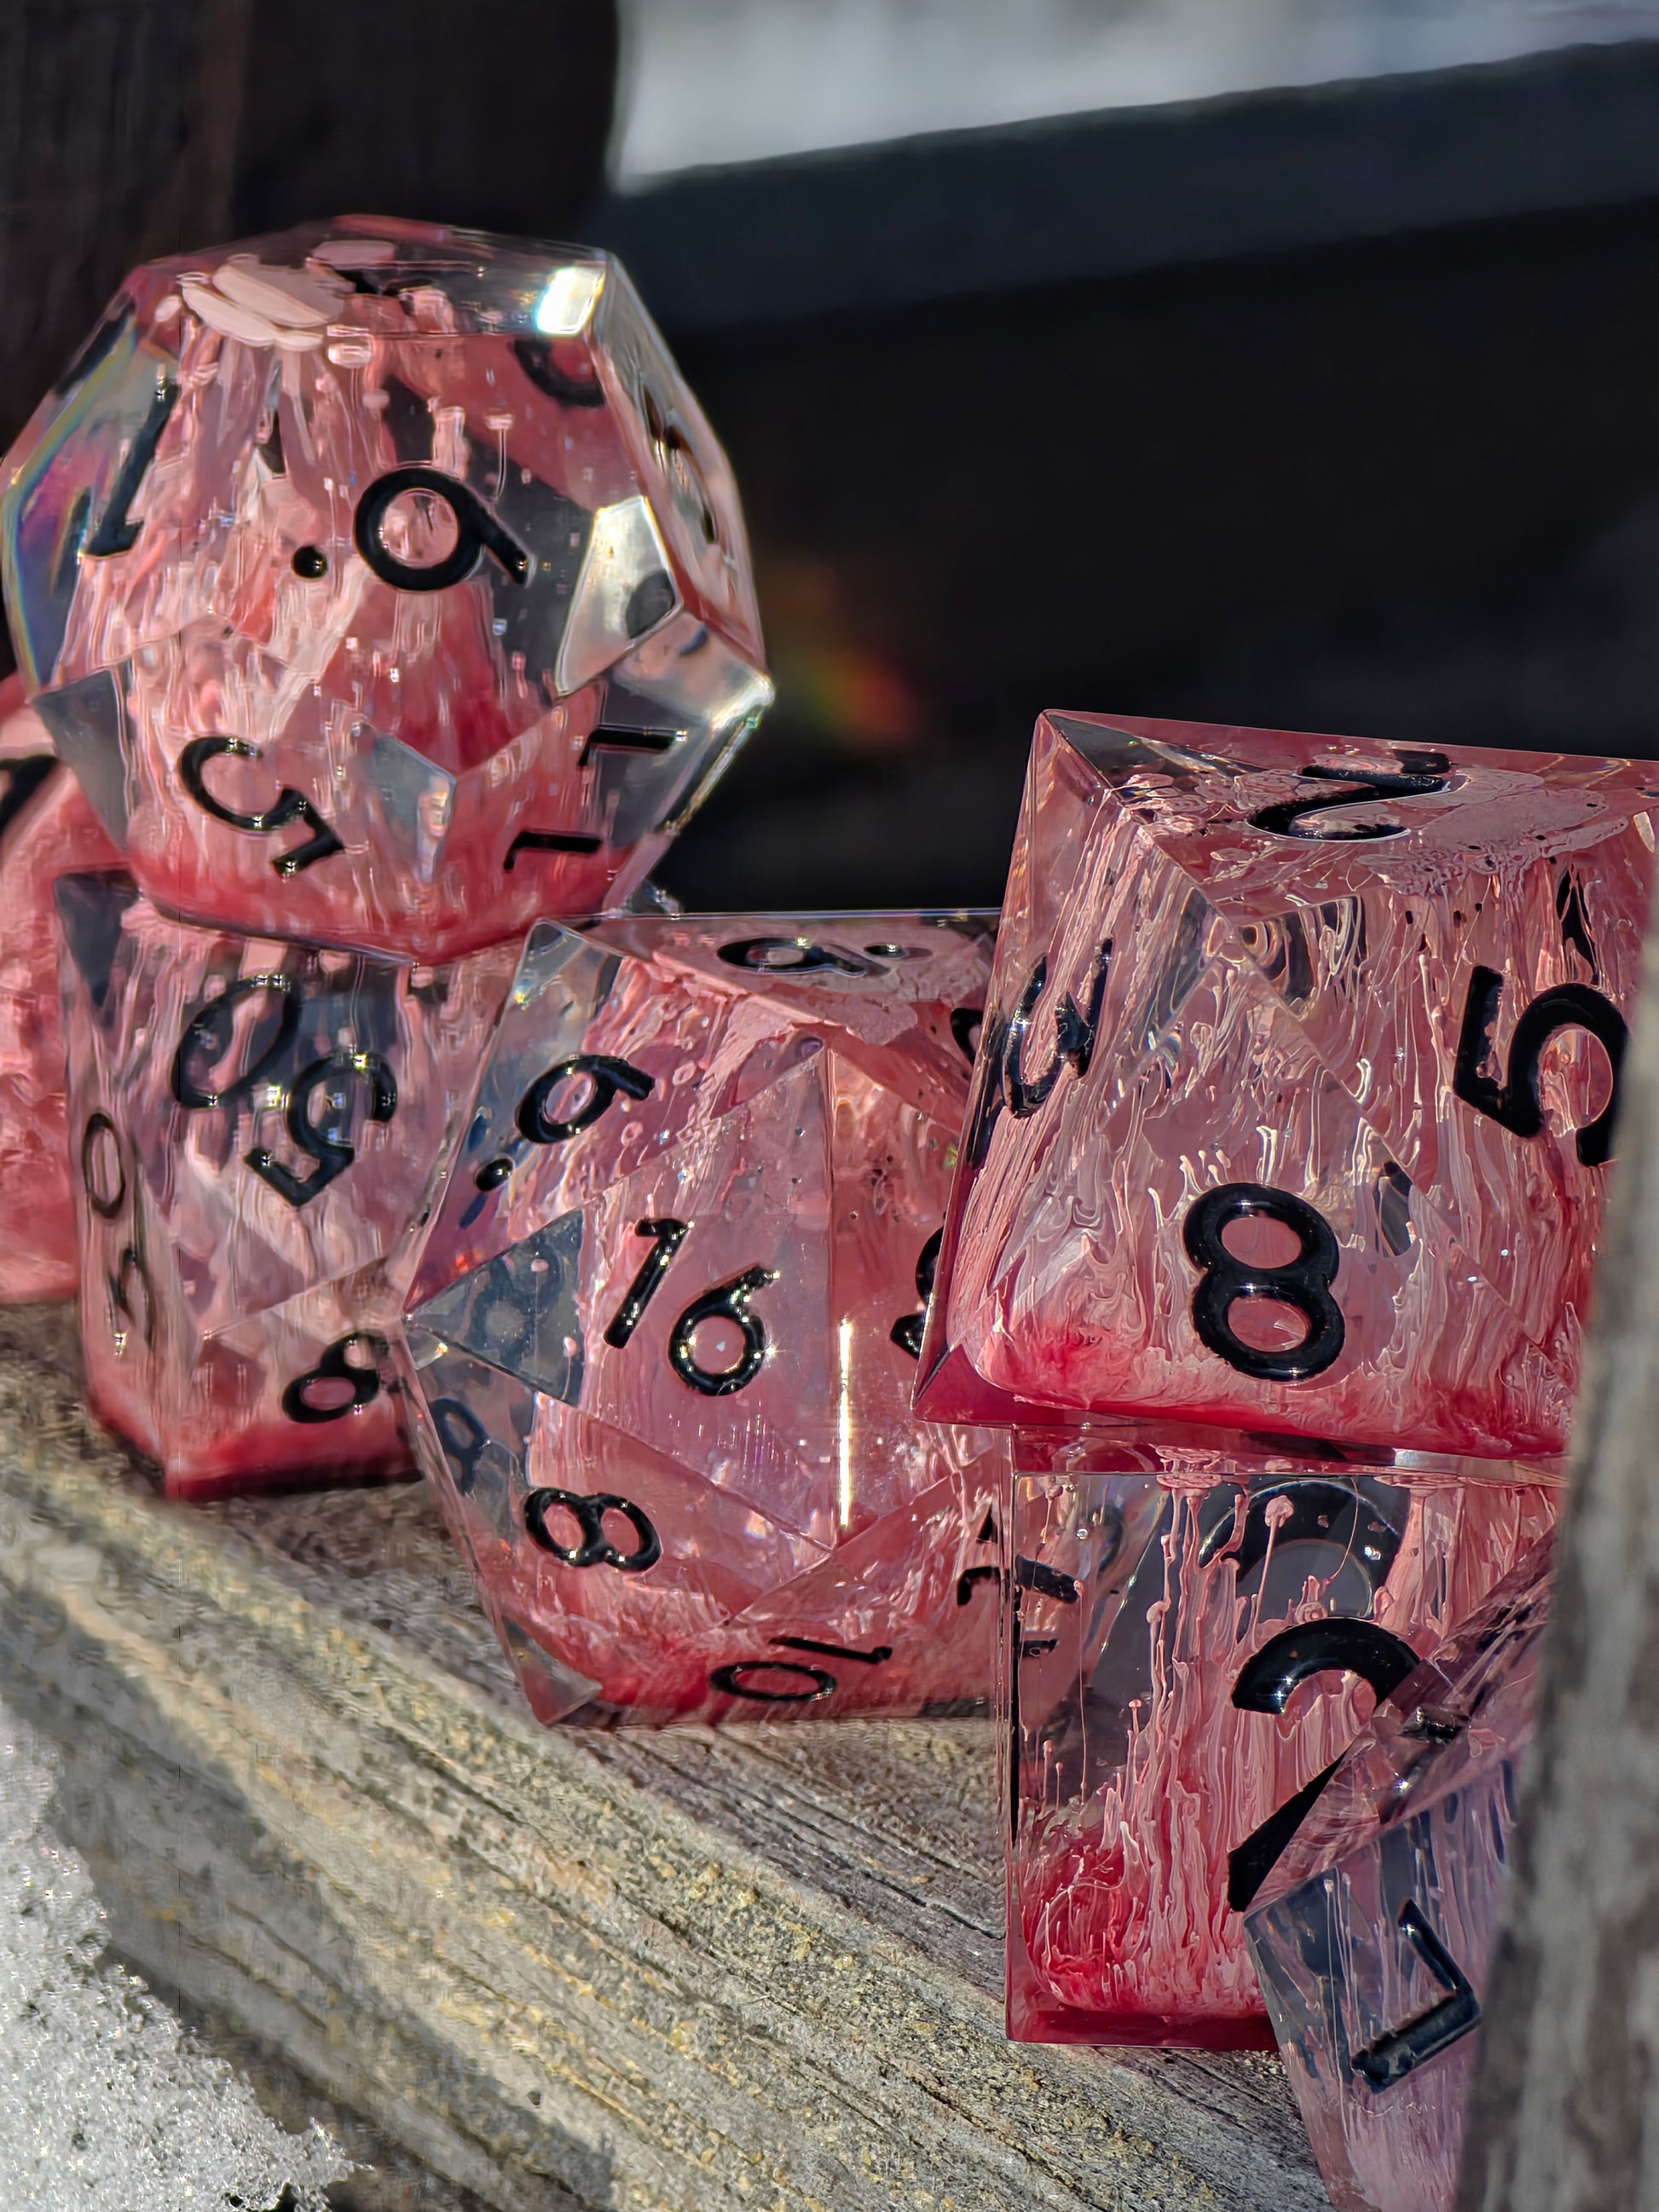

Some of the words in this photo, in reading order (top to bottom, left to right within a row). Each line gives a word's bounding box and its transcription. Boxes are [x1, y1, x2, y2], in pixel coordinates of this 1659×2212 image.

[1453, 965, 1627, 1166] 5
[603, 1217, 780, 1396] 16
[1183, 1182, 1345, 1383] 8
[523, 1487, 662, 1572] 8
